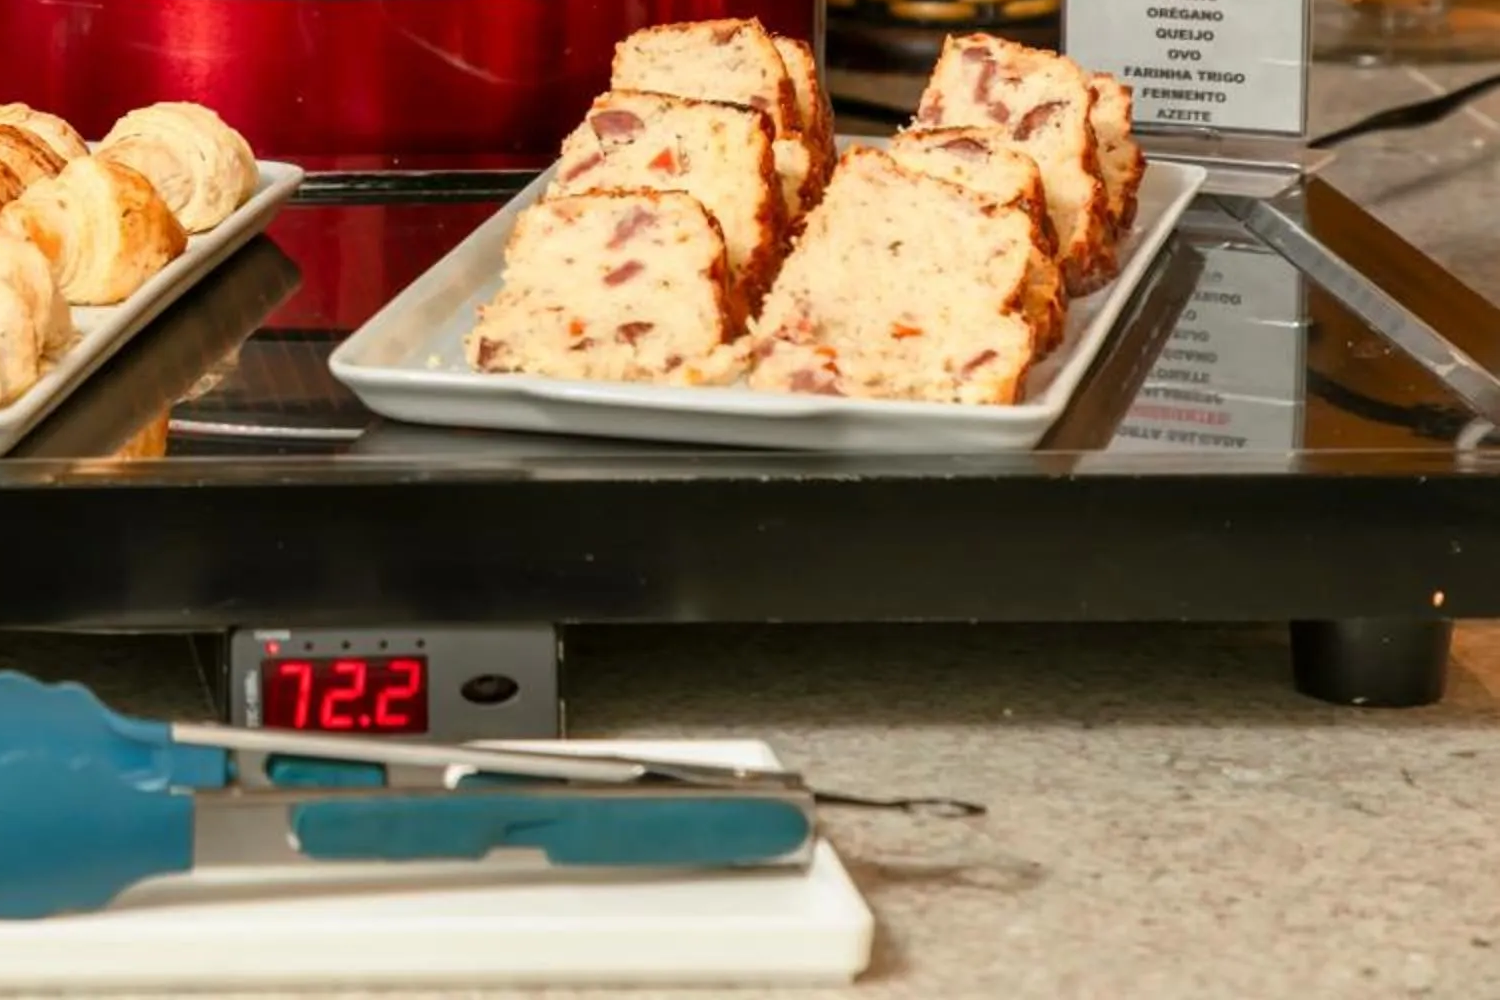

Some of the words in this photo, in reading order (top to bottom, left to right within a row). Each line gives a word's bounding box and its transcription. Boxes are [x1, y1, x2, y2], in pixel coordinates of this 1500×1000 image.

[1156, 28, 1215, 42] QUEIJO
[1167, 48, 1202, 61] OVO
[1123, 66, 1193, 81] FARINHA
[1197, 70, 1246, 84] TRIGO
[1142, 87, 1227, 103] FERMENTO
[1156, 108, 1212, 122] AZEITE
[279, 659, 421, 729] 72.2
